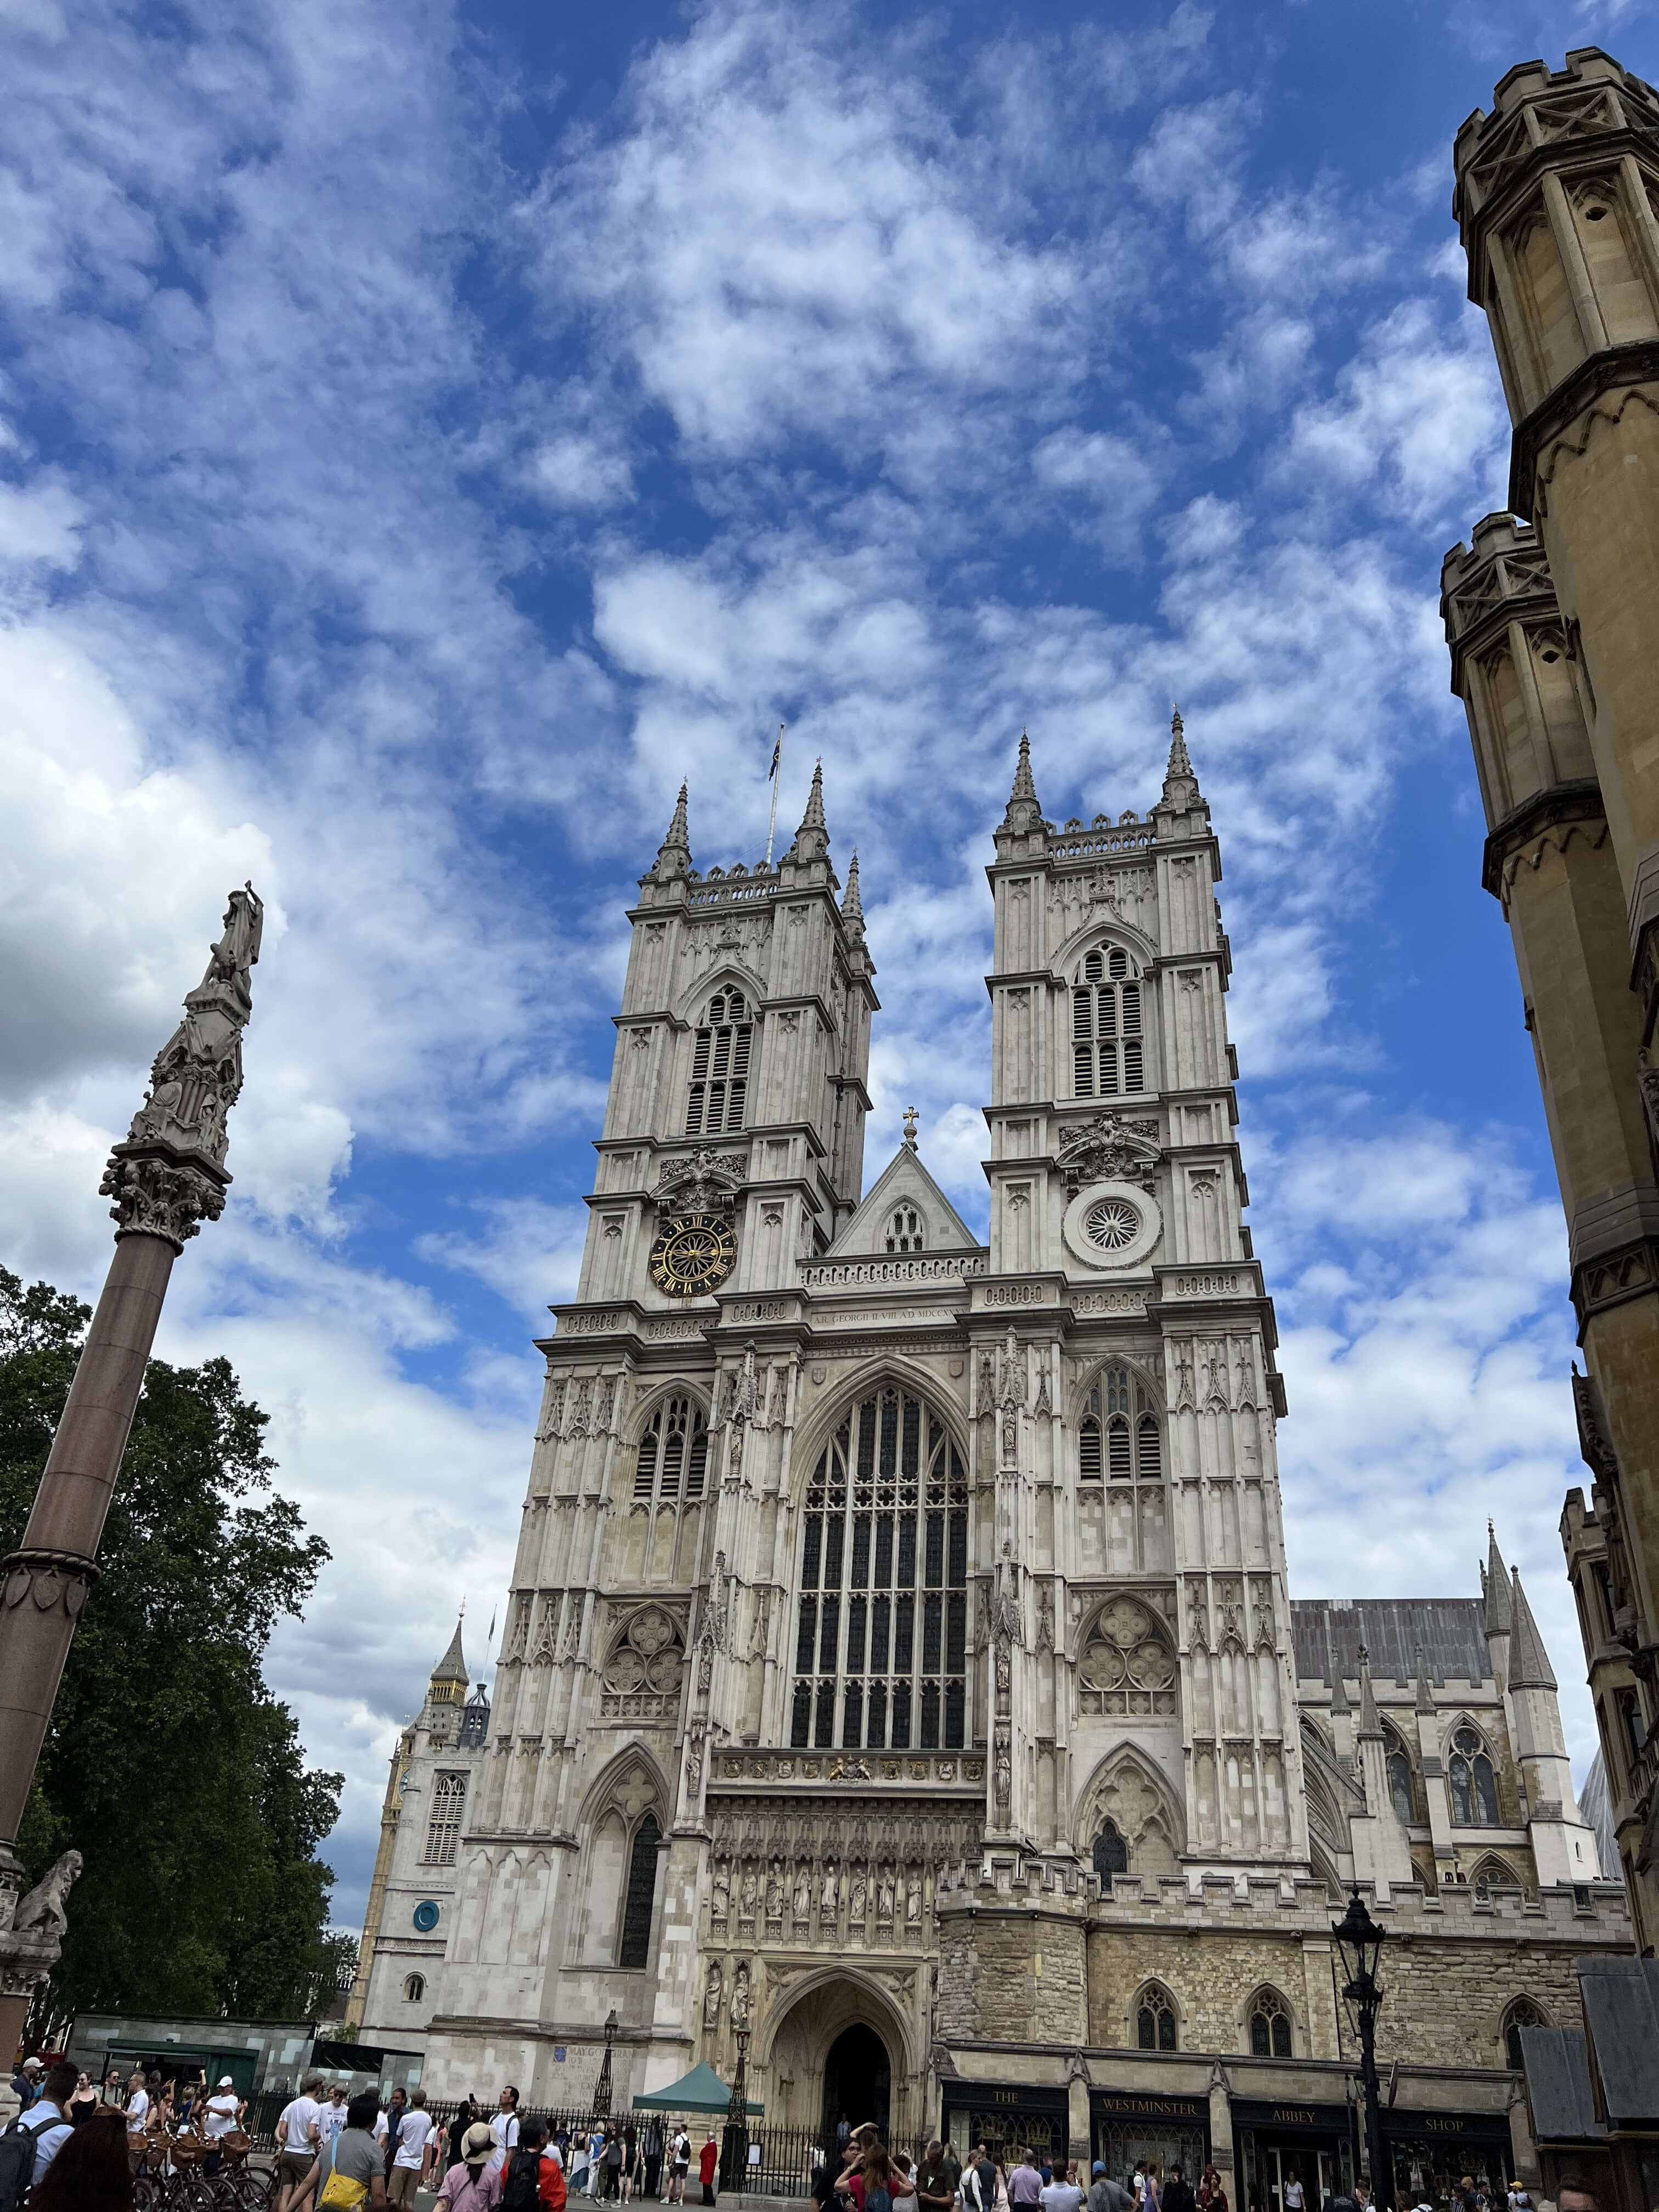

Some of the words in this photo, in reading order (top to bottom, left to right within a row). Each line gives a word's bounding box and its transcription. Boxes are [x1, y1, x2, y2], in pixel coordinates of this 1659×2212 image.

[674, 1221, 685, 1233] XI
[691, 1216, 702, 1227] XII
[709, 1220, 718, 1229] I
[658, 1234, 670, 1244] X
[719, 1231, 731, 1240] II
[651, 1252, 663, 1261] IX
[721, 1248, 733, 1256] III
[653, 1266, 667, 1282] VIII
[714, 1262, 729, 1276] IIII
[664, 1277, 676, 1291] VII
[684, 1282, 692, 1293] VI
[704, 1277, 712, 1288] V
[832, 1313, 868, 1323] GEORGII
[992, 2091, 1019, 2103] THE
[1102, 2098, 1198, 2116] WESTMINSTER
[1272, 2111, 1316, 2123] ABBEY
[1426, 2119, 1464, 2132] SHOP
